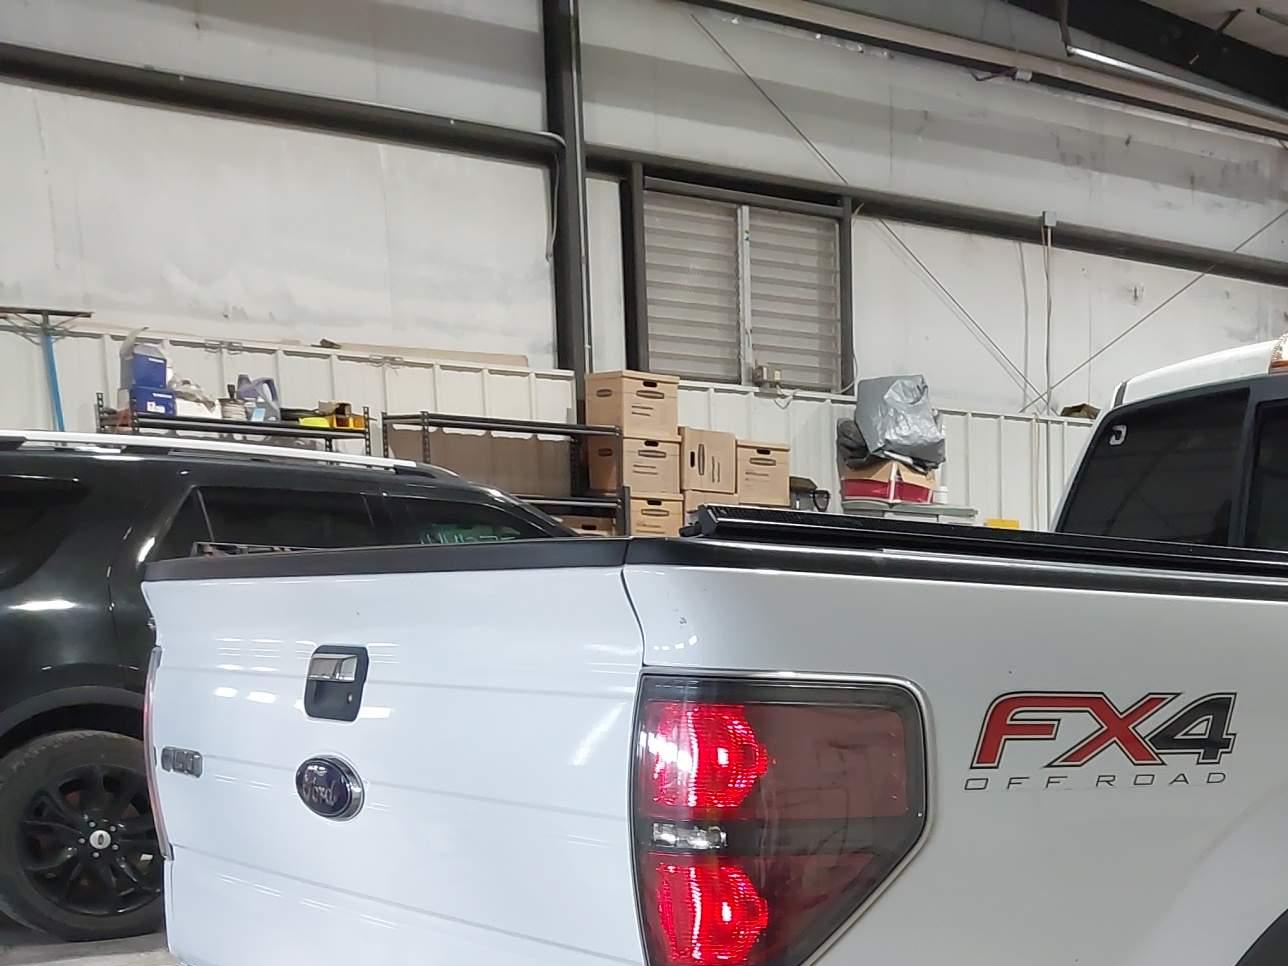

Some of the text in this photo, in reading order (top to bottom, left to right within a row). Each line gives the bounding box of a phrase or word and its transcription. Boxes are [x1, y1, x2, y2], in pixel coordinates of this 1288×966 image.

[970, 690, 1237, 769] FX4
[964, 772, 1226, 791] OFF ROAD
